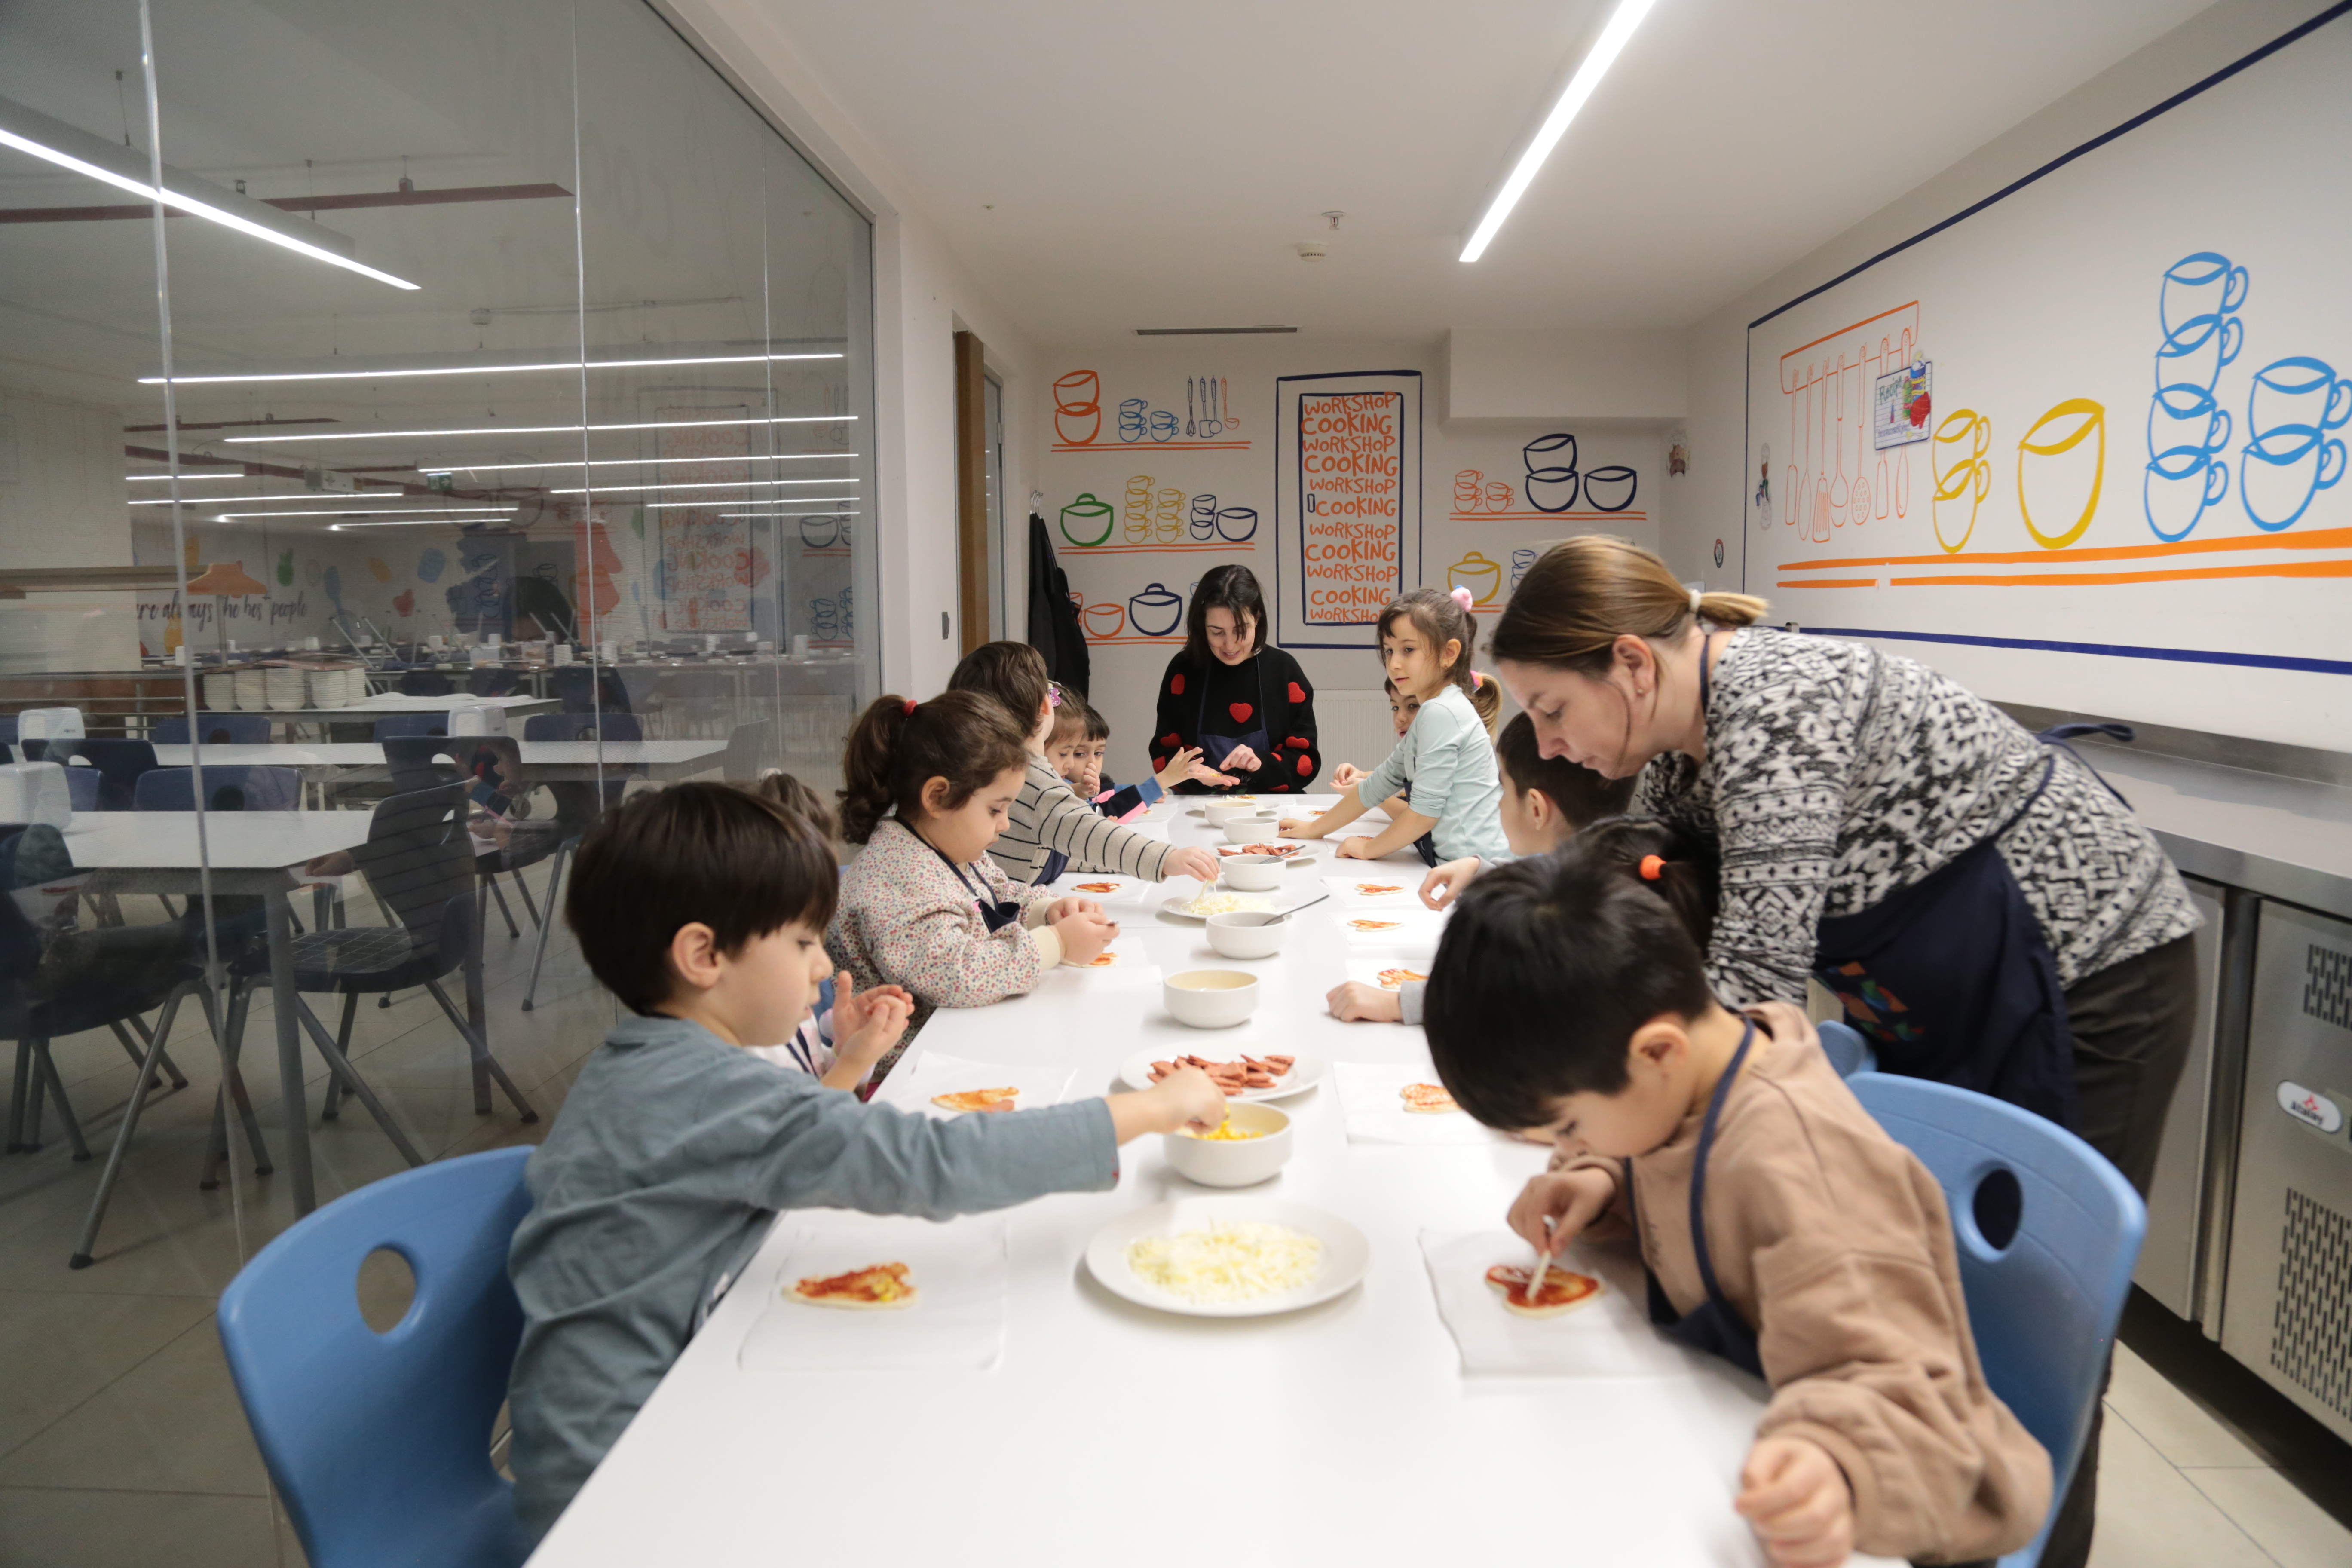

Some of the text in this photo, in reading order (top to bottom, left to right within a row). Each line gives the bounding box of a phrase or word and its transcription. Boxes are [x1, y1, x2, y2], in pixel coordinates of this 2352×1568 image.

[1304, 392, 1397, 415] WORKSHOP
[1301, 413, 1392, 436] COOKING
[1303, 436, 1396, 453] WORKSHOP
[1304, 450, 1398, 476] COOKING
[1310, 477, 1396, 494] WORKSHOP
[1315, 496, 1396, 518] COOKING
[1309, 523, 1396, 540] WORKSHOP
[1305, 539, 1396, 563] COOKING
[1307, 564, 1399, 582] WORKSHOP
[1311, 585, 1391, 606] COOKING
